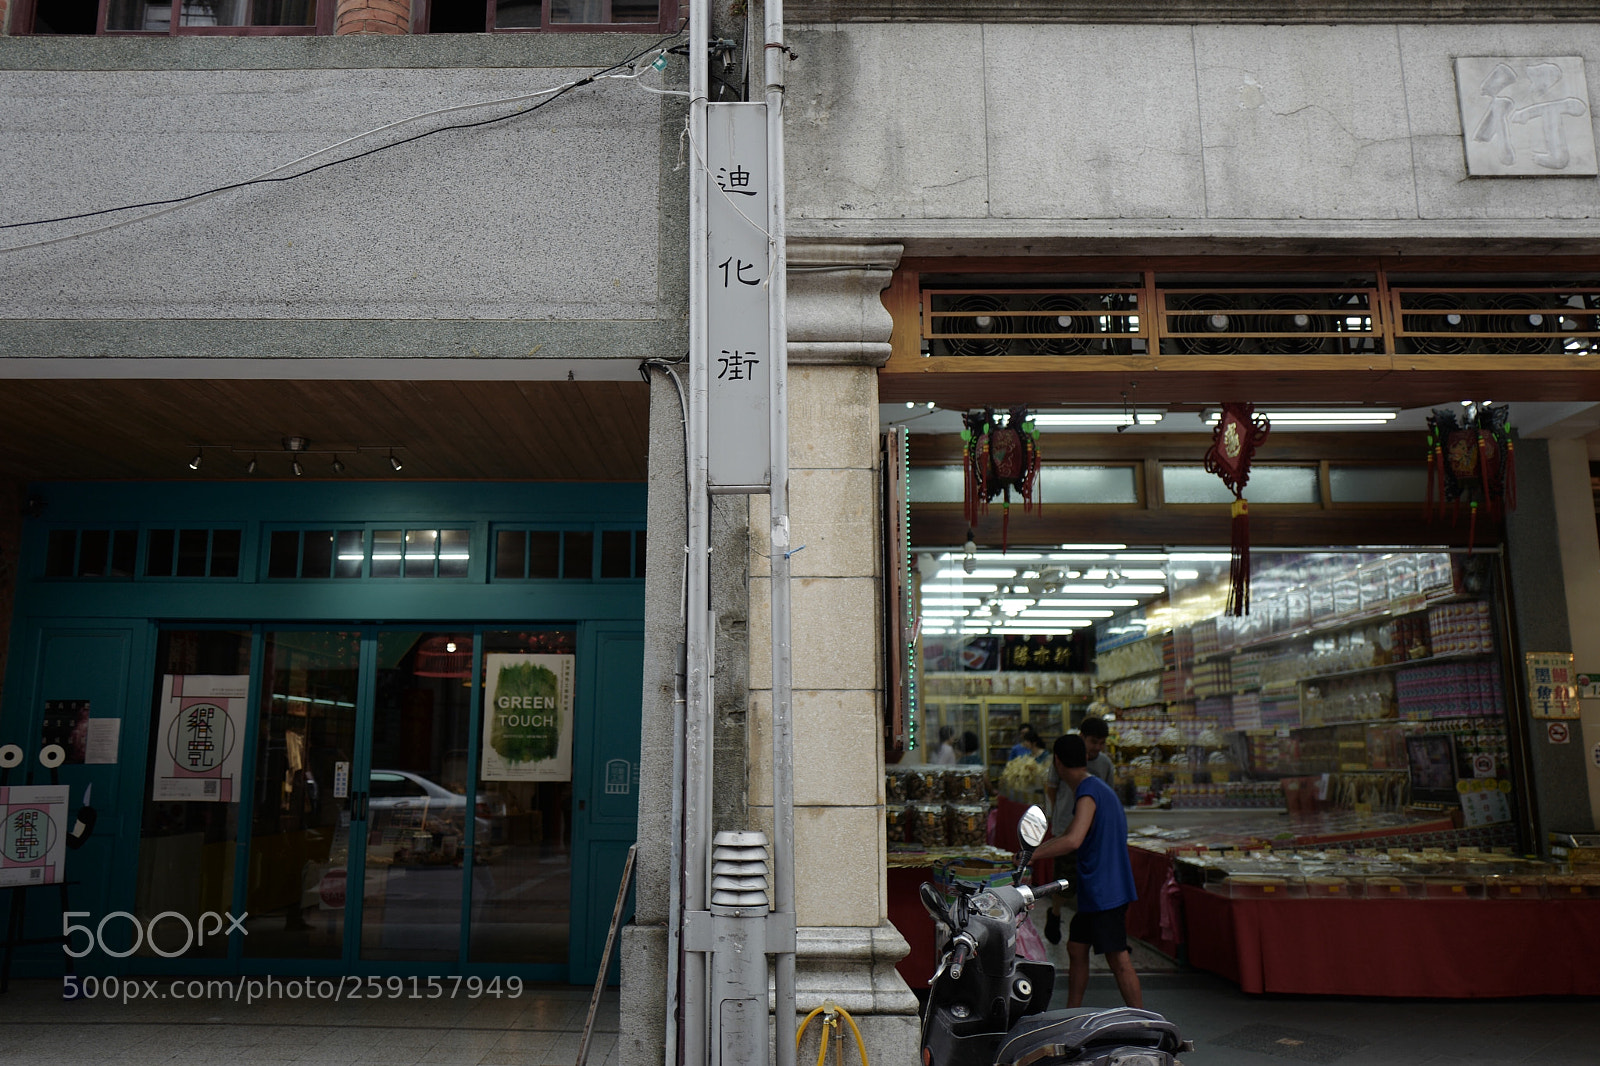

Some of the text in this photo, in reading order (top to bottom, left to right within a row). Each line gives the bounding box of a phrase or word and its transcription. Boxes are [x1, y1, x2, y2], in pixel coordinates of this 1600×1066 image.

[717, 164, 761, 381] 迪化街
[497, 695, 555, 709] GREEN
[498, 714, 554, 727] TOUCH
